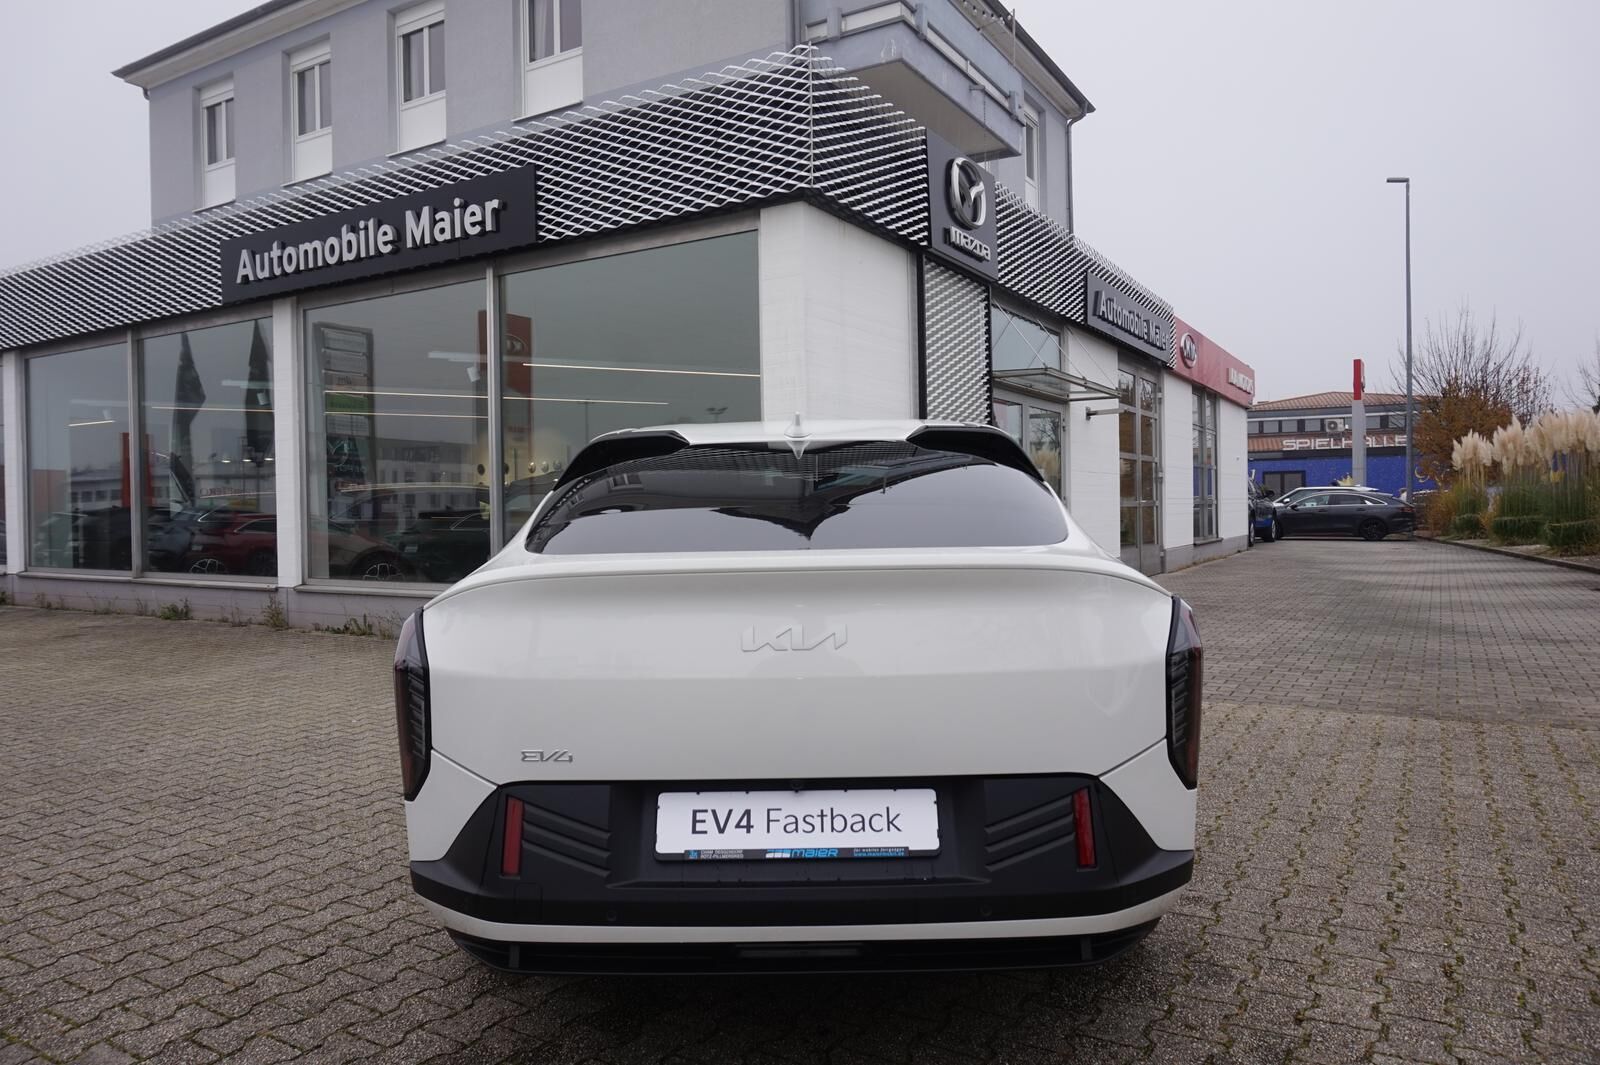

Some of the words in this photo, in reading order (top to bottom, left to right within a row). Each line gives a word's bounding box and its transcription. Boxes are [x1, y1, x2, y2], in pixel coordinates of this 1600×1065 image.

[236, 217, 395, 284] Automobile
[405, 198, 499, 248] Maier
[1100, 290, 1148, 340] Automobile
[521, 749, 573, 763] EV4
[690, 808, 754, 835] EV4
[765, 806, 903, 834] Fastback
